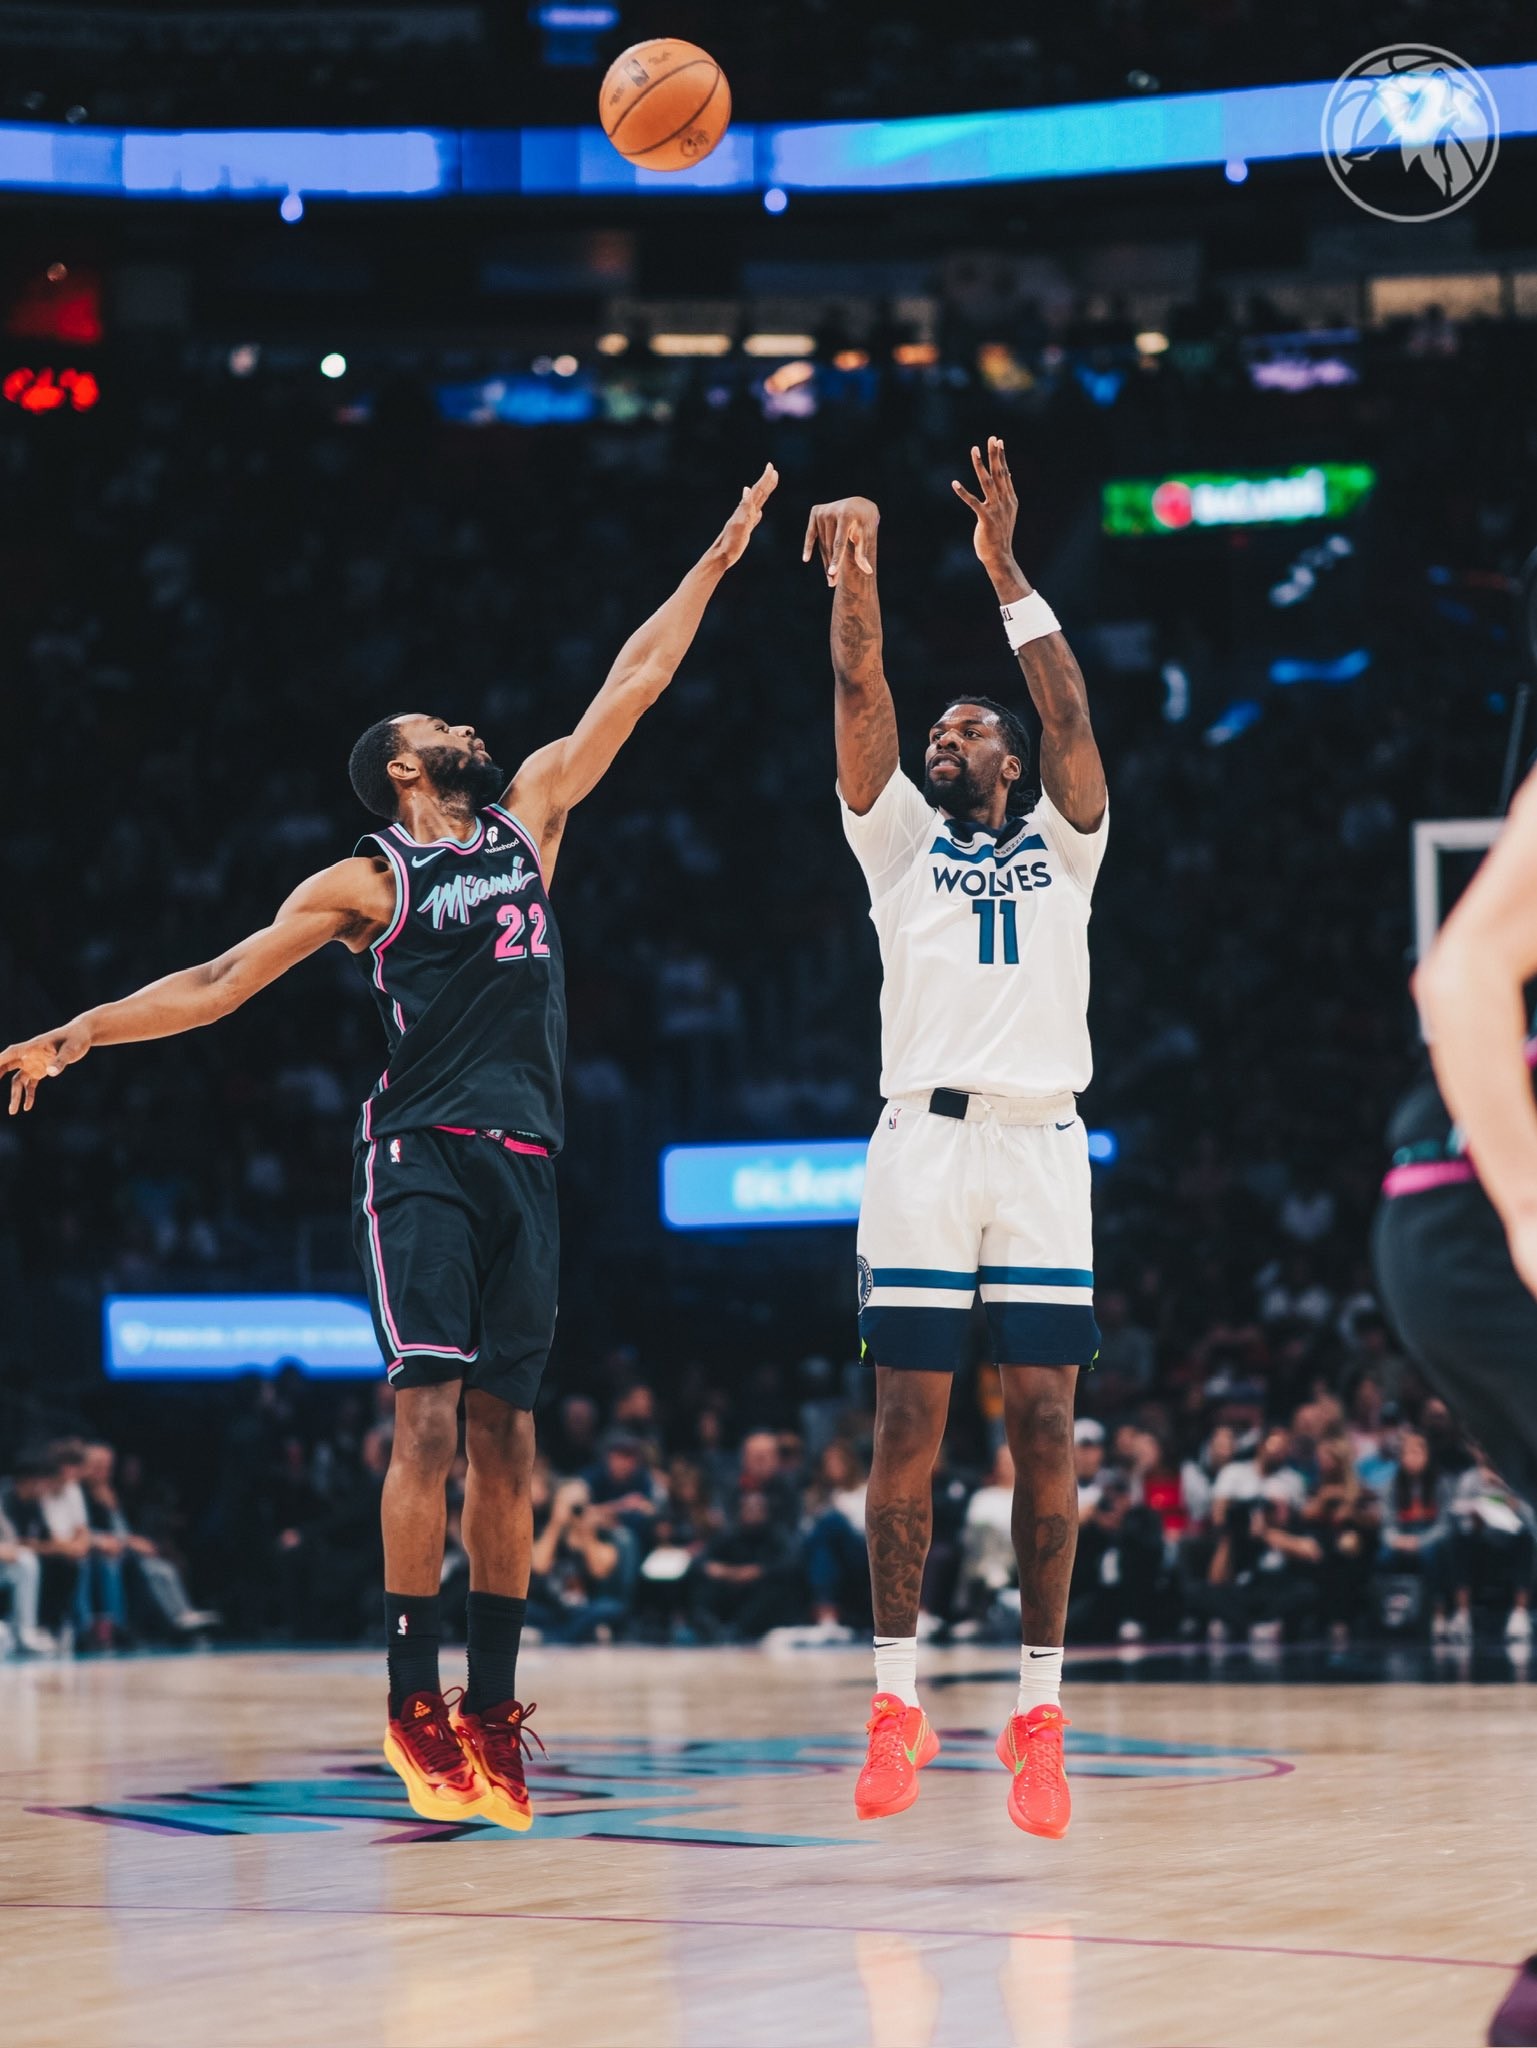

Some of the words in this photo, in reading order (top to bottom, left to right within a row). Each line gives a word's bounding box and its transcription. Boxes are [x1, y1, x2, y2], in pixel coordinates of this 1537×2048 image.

[484, 837, 520, 854] Robinhood
[416, 856, 538, 930] Miami
[932, 861, 1053, 897] WOLVES
[494, 902, 550, 961] 22
[972, 899, 1020, 964] 11
